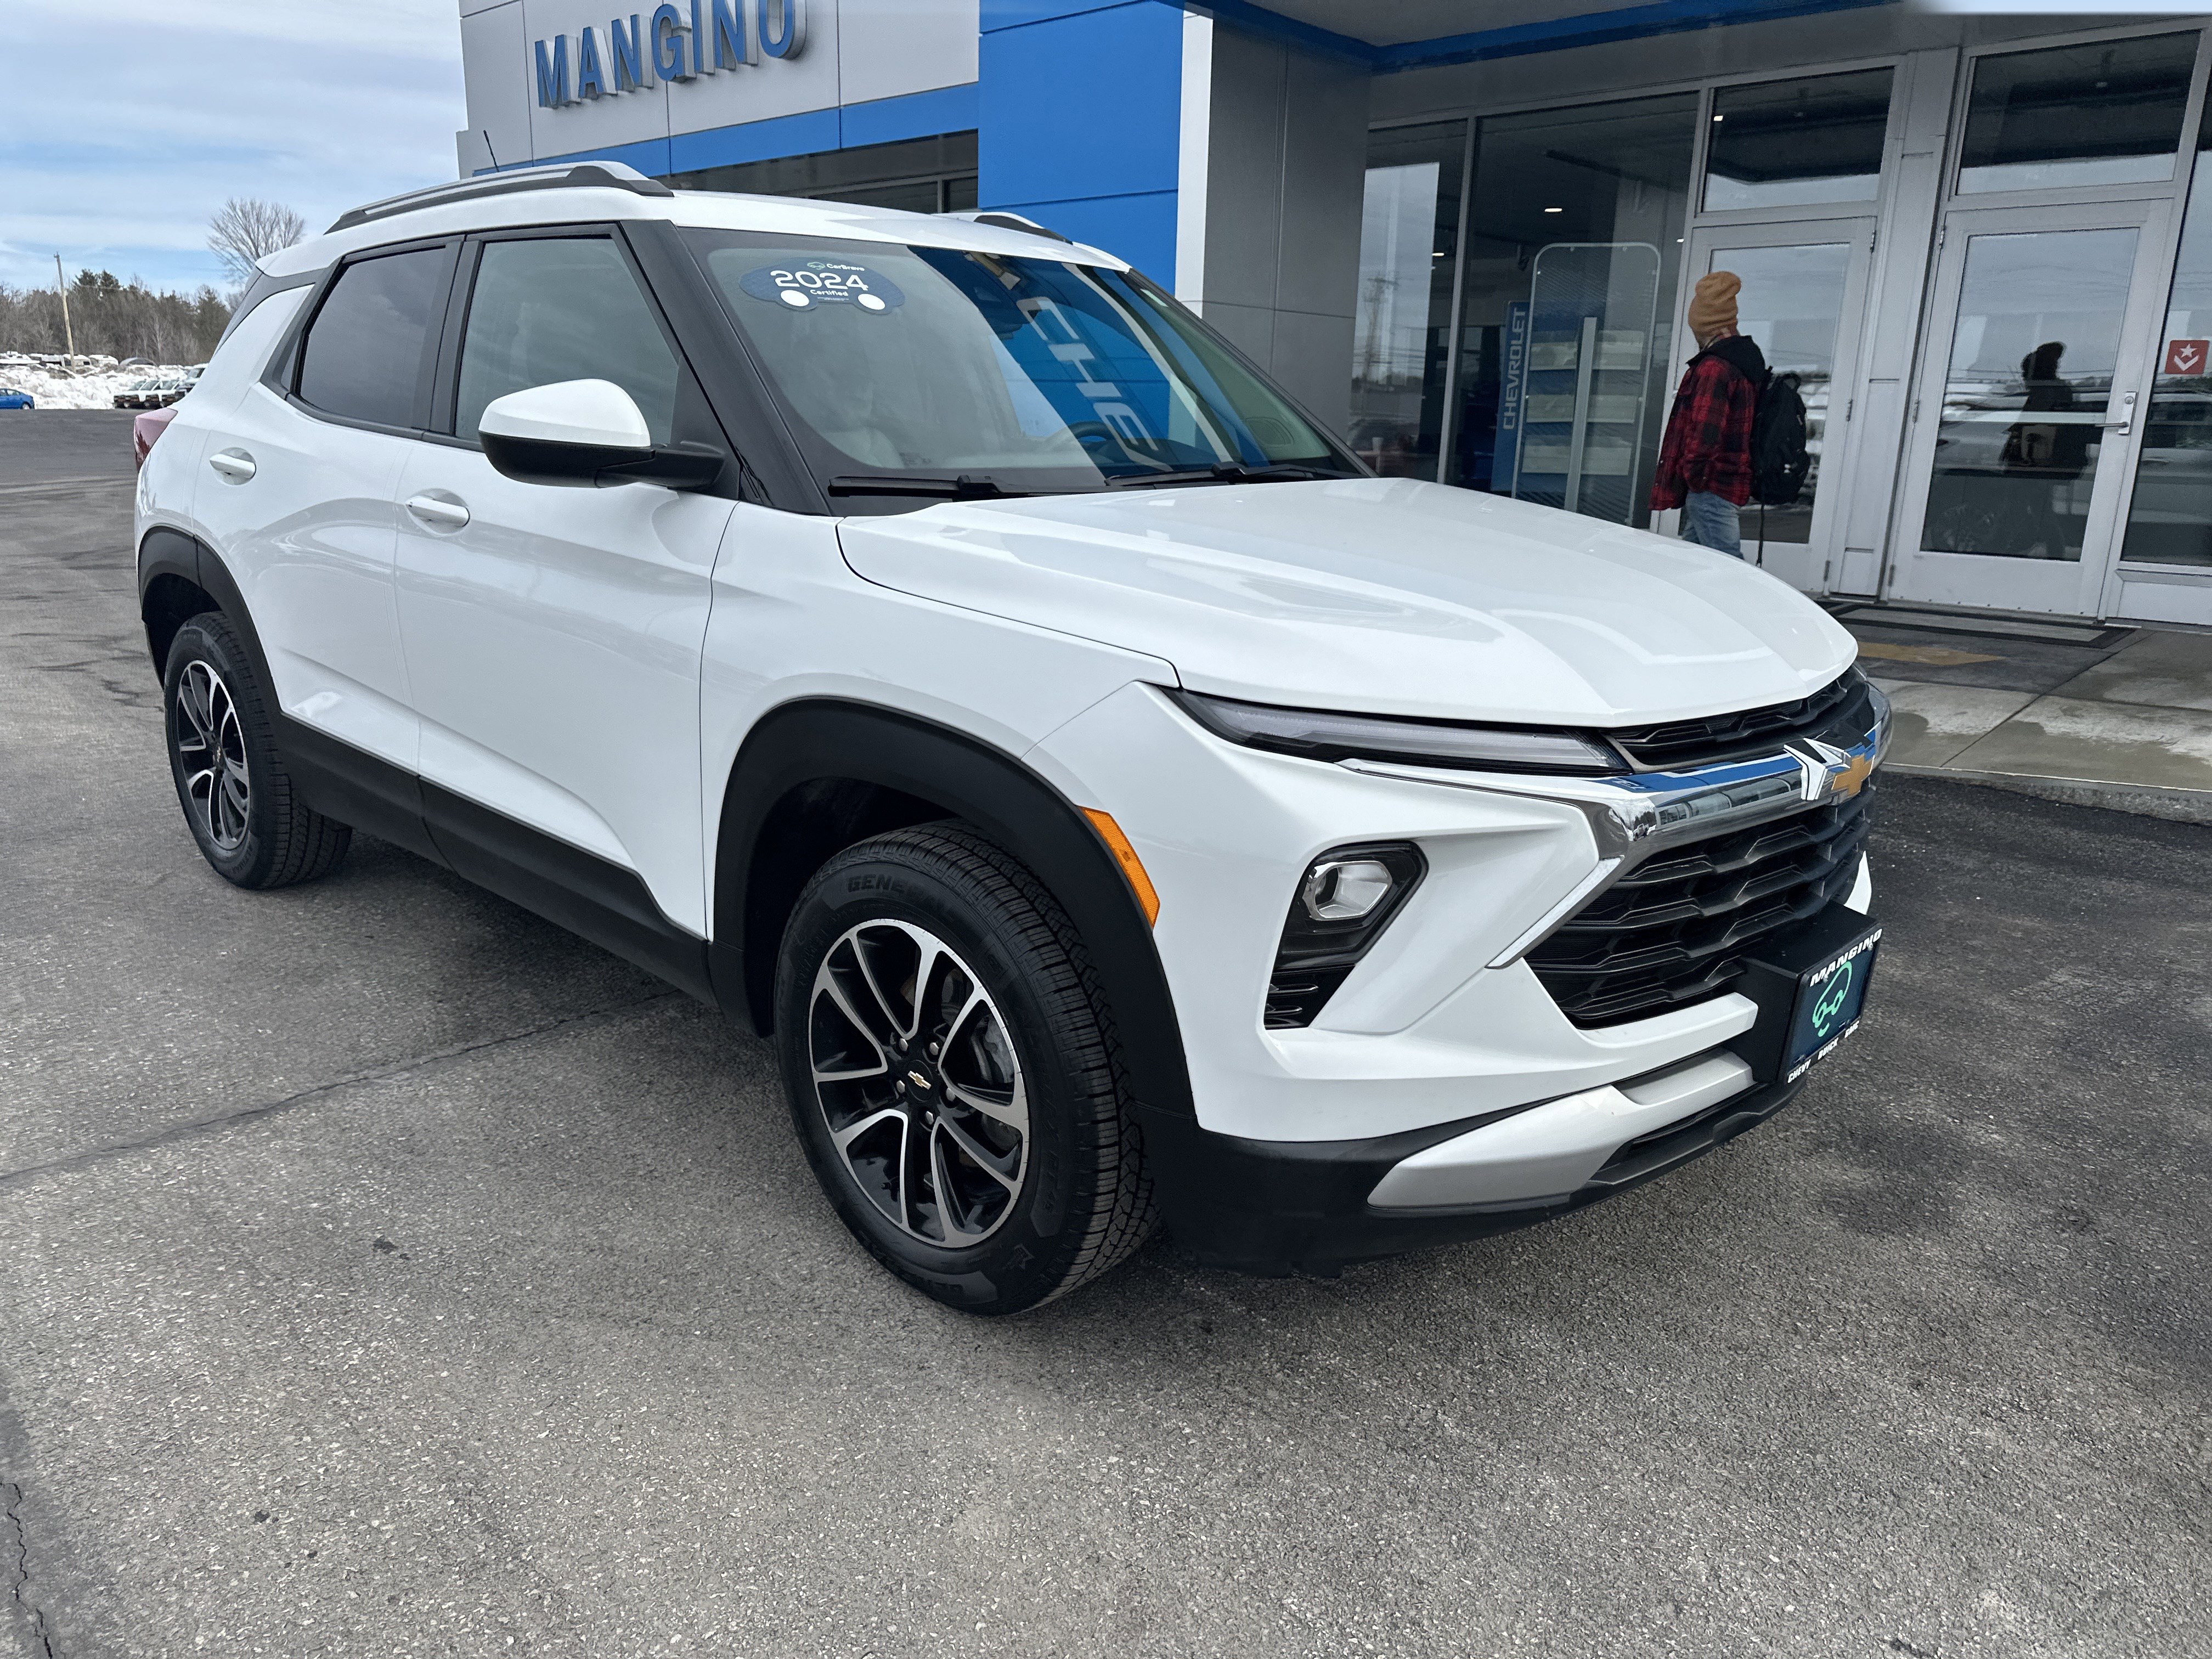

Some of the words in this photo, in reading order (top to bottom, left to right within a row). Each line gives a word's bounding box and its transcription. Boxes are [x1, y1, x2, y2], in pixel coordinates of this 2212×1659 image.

[534, 0, 805, 109] MANGINO
[770, 270, 869, 291] 2024
[1502, 307, 1526, 430] CHEVROLET
[1810, 928, 1882, 987] MANGINO
[1787, 1059, 1811, 1083] CHEVY
[1818, 1037, 1838, 1060] BUICK
